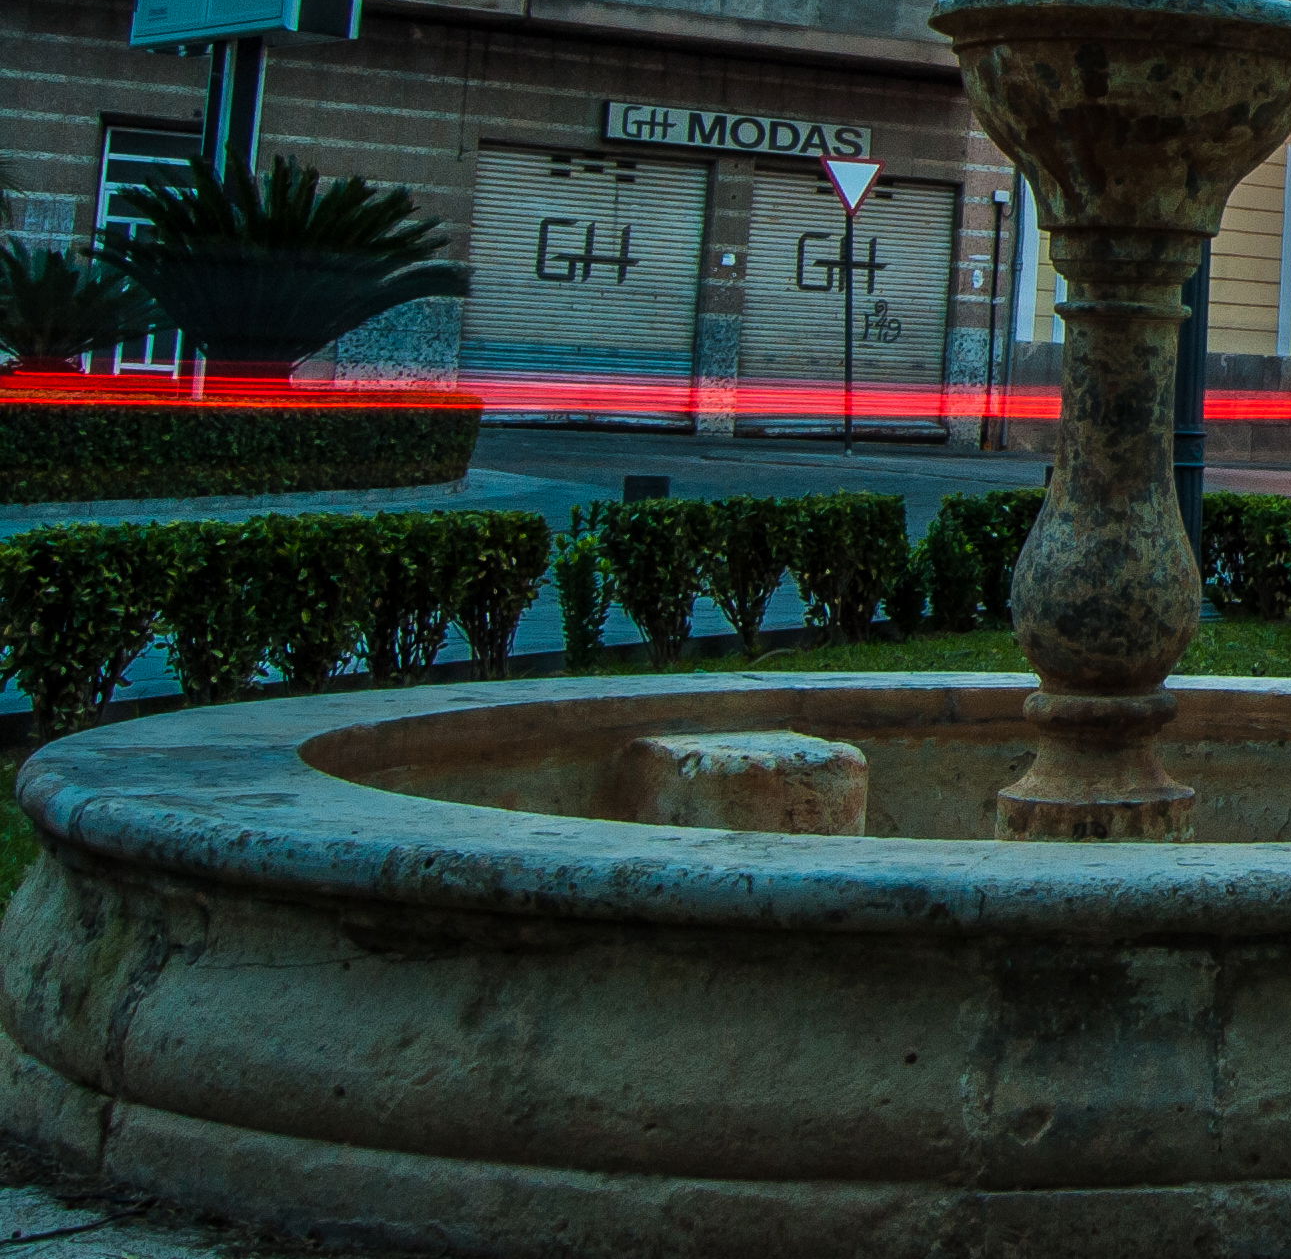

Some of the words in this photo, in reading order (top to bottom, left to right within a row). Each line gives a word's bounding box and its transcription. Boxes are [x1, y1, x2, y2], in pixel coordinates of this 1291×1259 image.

[621, 105, 677, 140] GH
[687, 112, 863, 158] MODAS
[536, 217, 640, 284] GH
